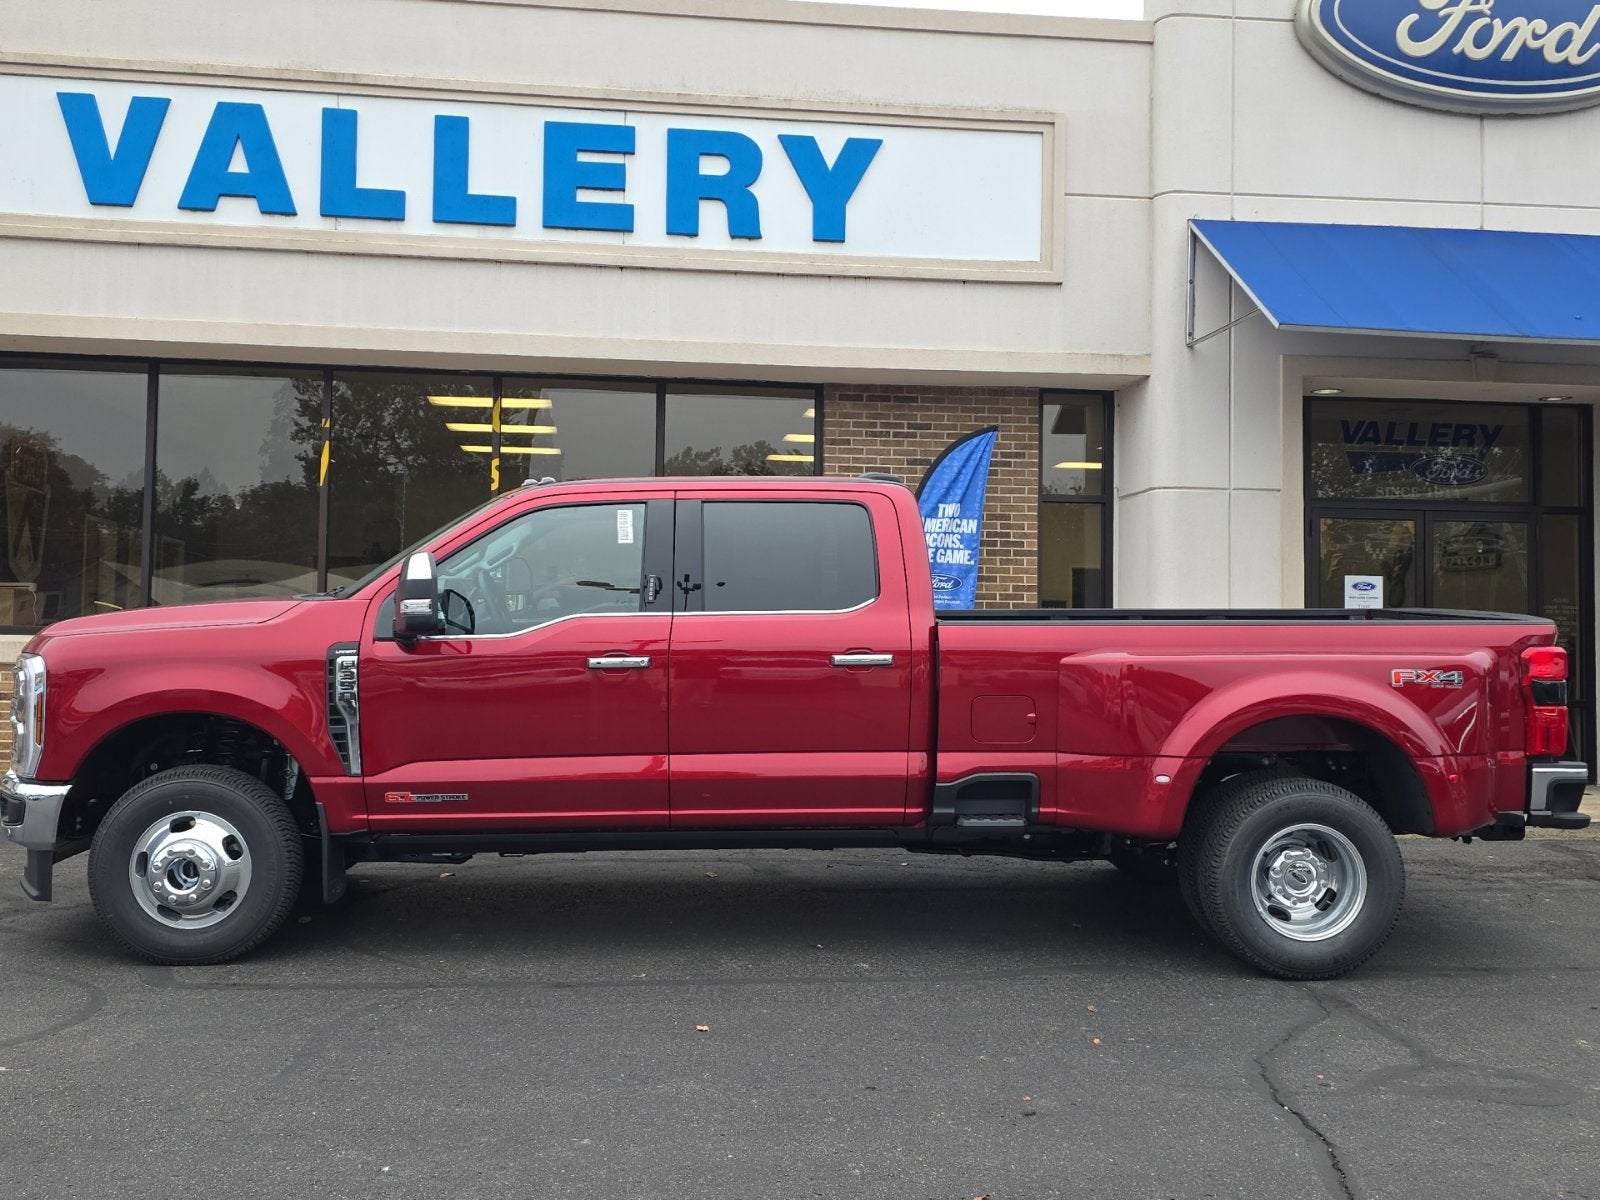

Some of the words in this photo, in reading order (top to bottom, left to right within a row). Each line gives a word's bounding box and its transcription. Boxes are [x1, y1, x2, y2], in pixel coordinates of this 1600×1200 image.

[1396, 0, 1600, 66] Ford
[56, 92, 883, 243] VALLERY
[1340, 419, 1504, 457] VALLERY
[1425, 456, 1474, 480] Ford
[938, 503, 960, 518] TWO
[922, 517, 978, 533] MERICAN
[936, 548, 975, 565] GAME.
[1445, 555, 1490, 567] FALCON
[1392, 669, 1463, 687] FX4
